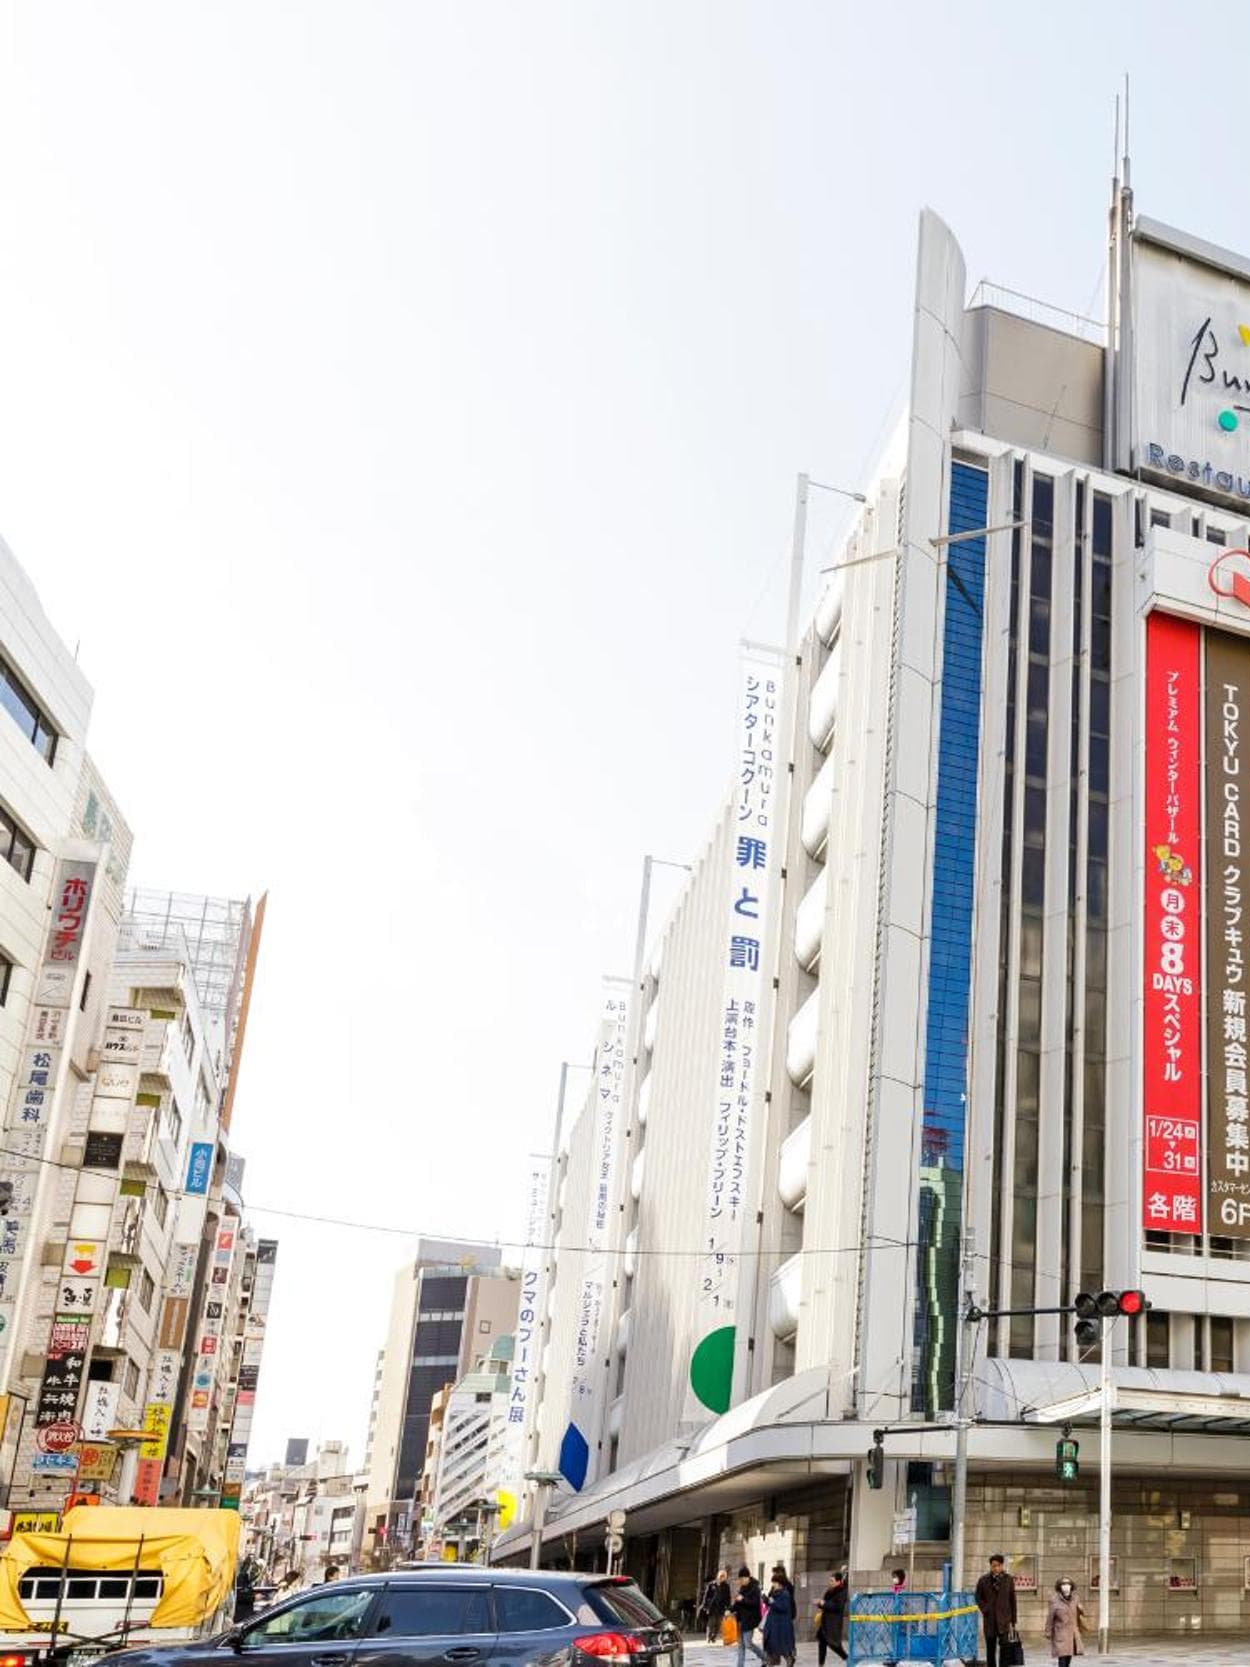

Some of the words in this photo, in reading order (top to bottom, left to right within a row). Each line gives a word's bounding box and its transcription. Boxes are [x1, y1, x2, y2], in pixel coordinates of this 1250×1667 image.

[1167, 671, 1179, 732] プレミアム
[1223, 684, 1240, 774] TOKYU
[739, 676, 759, 821] シアターコクーン
[757, 680, 776, 826] Bunkamura
[1224, 783, 1241, 858] CARD
[54, 878, 88, 949] ホリウチ
[730, 836, 766, 972] 罪と罰
[1223, 865, 1243, 983] クラブキュウ
[1153, 973, 1192, 995] DAYS
[1161, 942, 1185, 975] 8
[1163, 993, 1182, 1081] スペシャル
[1222, 989, 1249, 1177] 新規会員募集中
[1147, 1192, 1197, 1222] 各階
